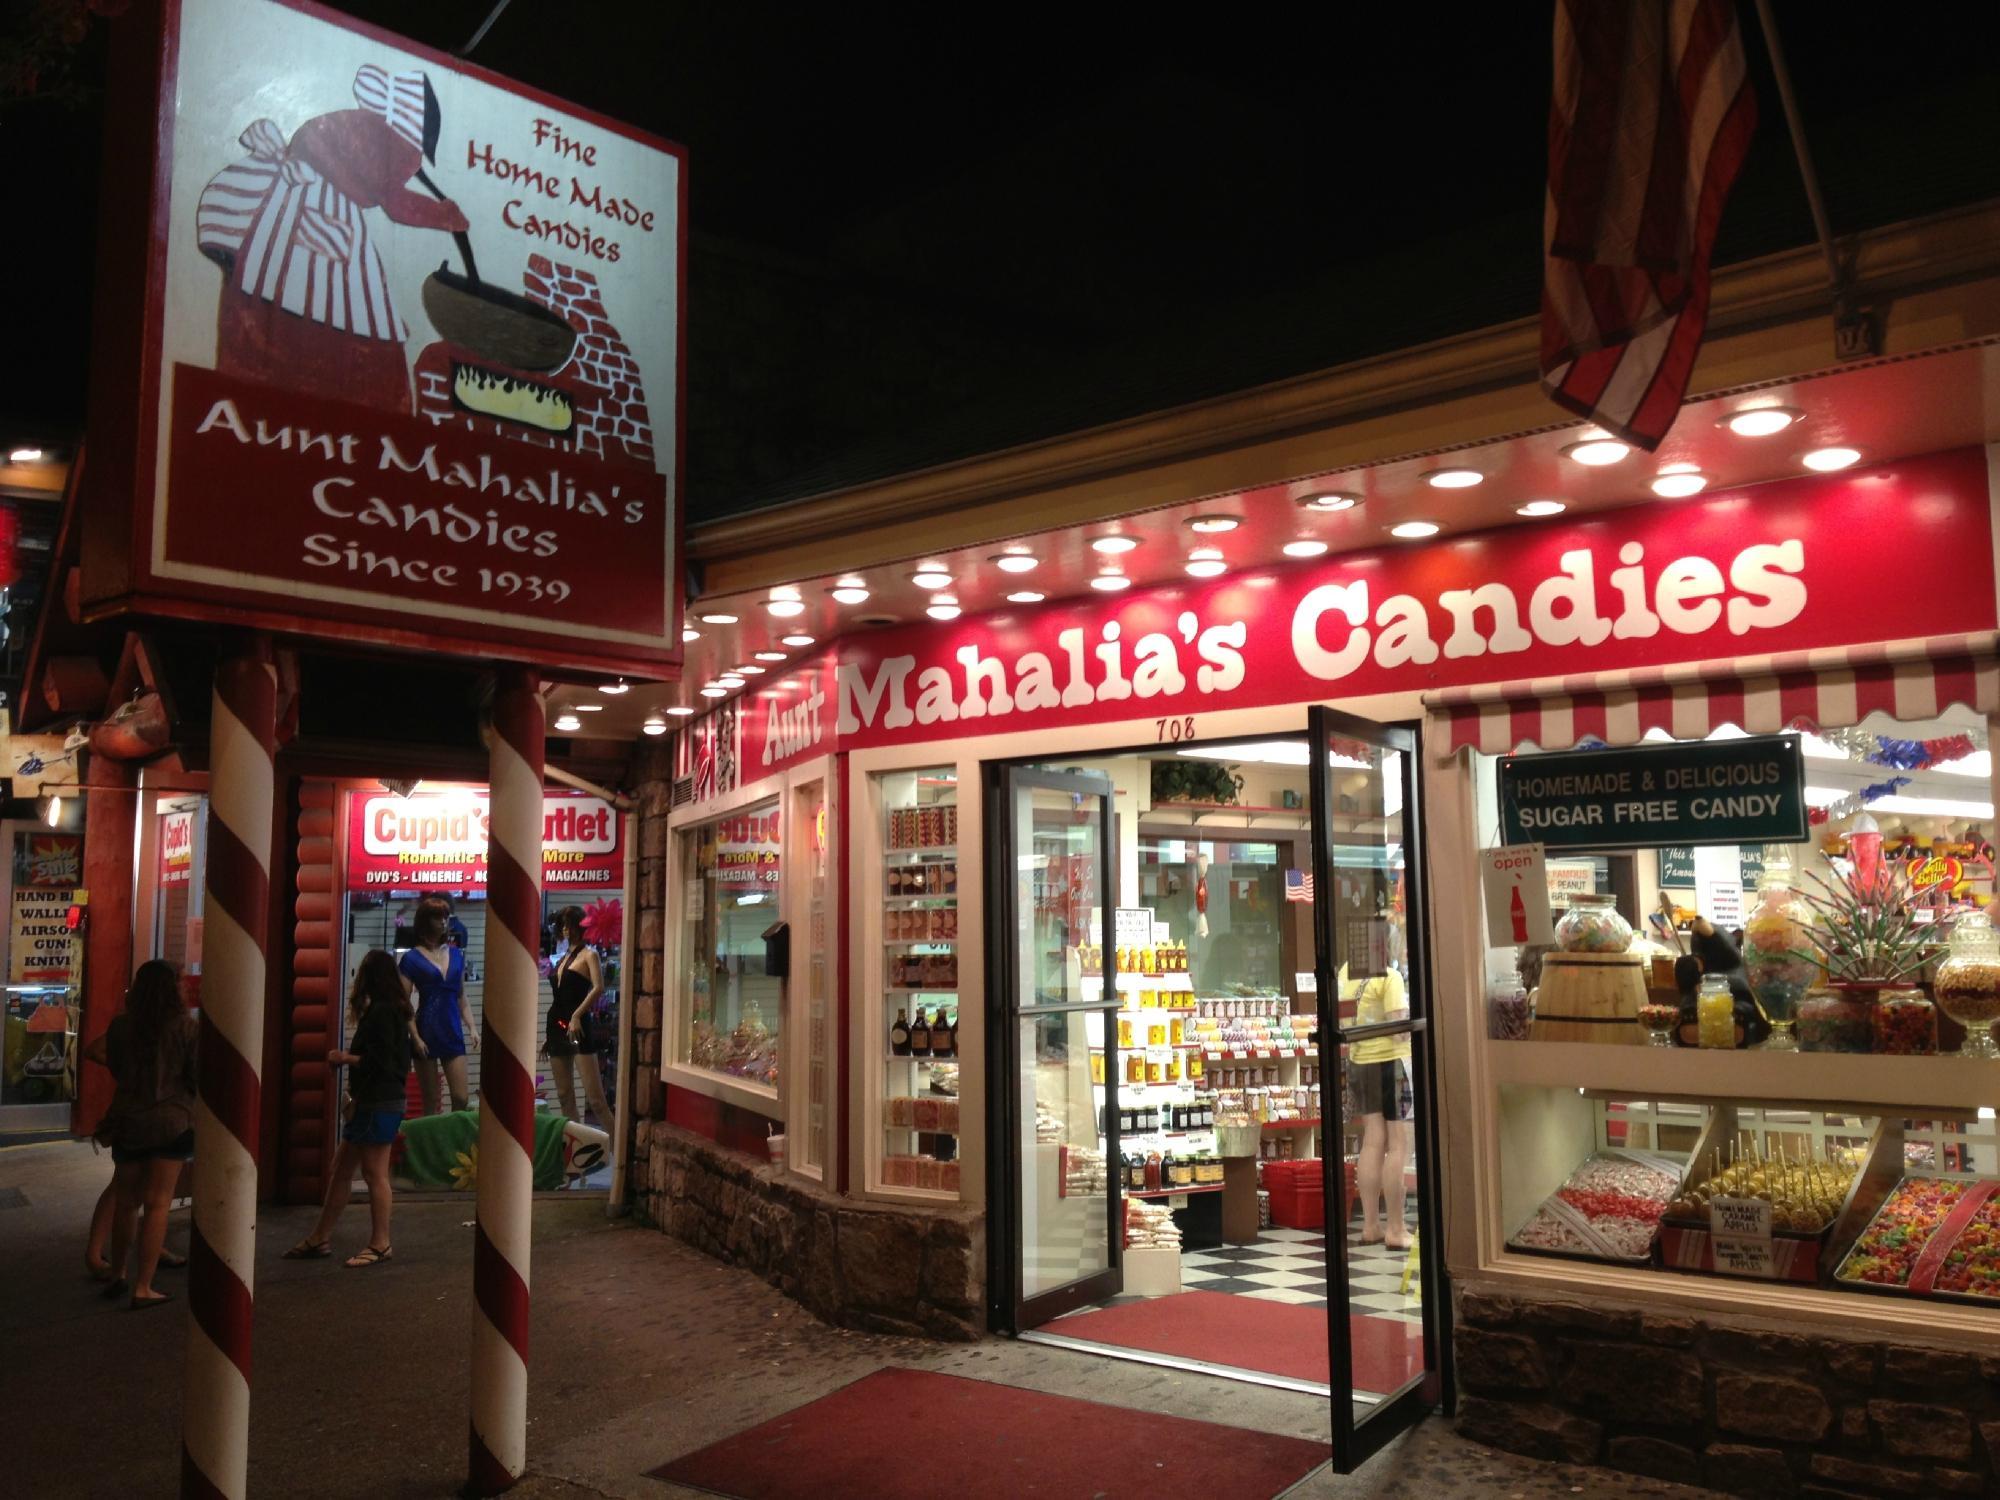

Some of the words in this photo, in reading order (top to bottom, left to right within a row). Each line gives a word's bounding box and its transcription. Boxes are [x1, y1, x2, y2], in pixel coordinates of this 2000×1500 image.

[533, 118, 597, 167] Fine
[466, 139, 560, 197] Home
[569, 177, 655, 232] Made
[503, 200, 622, 263] Candies
[196, 400, 360, 464] Aunt
[377, 436, 645, 525] Mahalia's
[312, 478, 558, 557] Candies
[302, 534, 458, 587] Since
[478, 568, 571, 603] 1939
[837, 611, 1247, 735] Mahalia's
[1291, 539, 1808, 680] Candies
[761, 679, 825, 766] Aunt
[1155, 716, 1195, 742] 708
[1517, 771, 1631, 798] HOMEMADE
[1641, 770, 1656, 791] &
[1665, 761, 1781, 790] DELICIOUS
[1519, 805, 1603, 828] SUGAR
[1614, 800, 1679, 823] FREE
[1690, 794, 1782, 820] CANDY
[366, 870, 400, 883] DVD'S
[411, 870, 463, 883] LINGERIE
[545, 869, 610, 882] MAGAZINES
[543, 849, 585, 863] More
[1494, 856, 1532, 871] open
[15, 891, 56, 902] HAND
[1557, 881, 1587, 890] PEANUT
